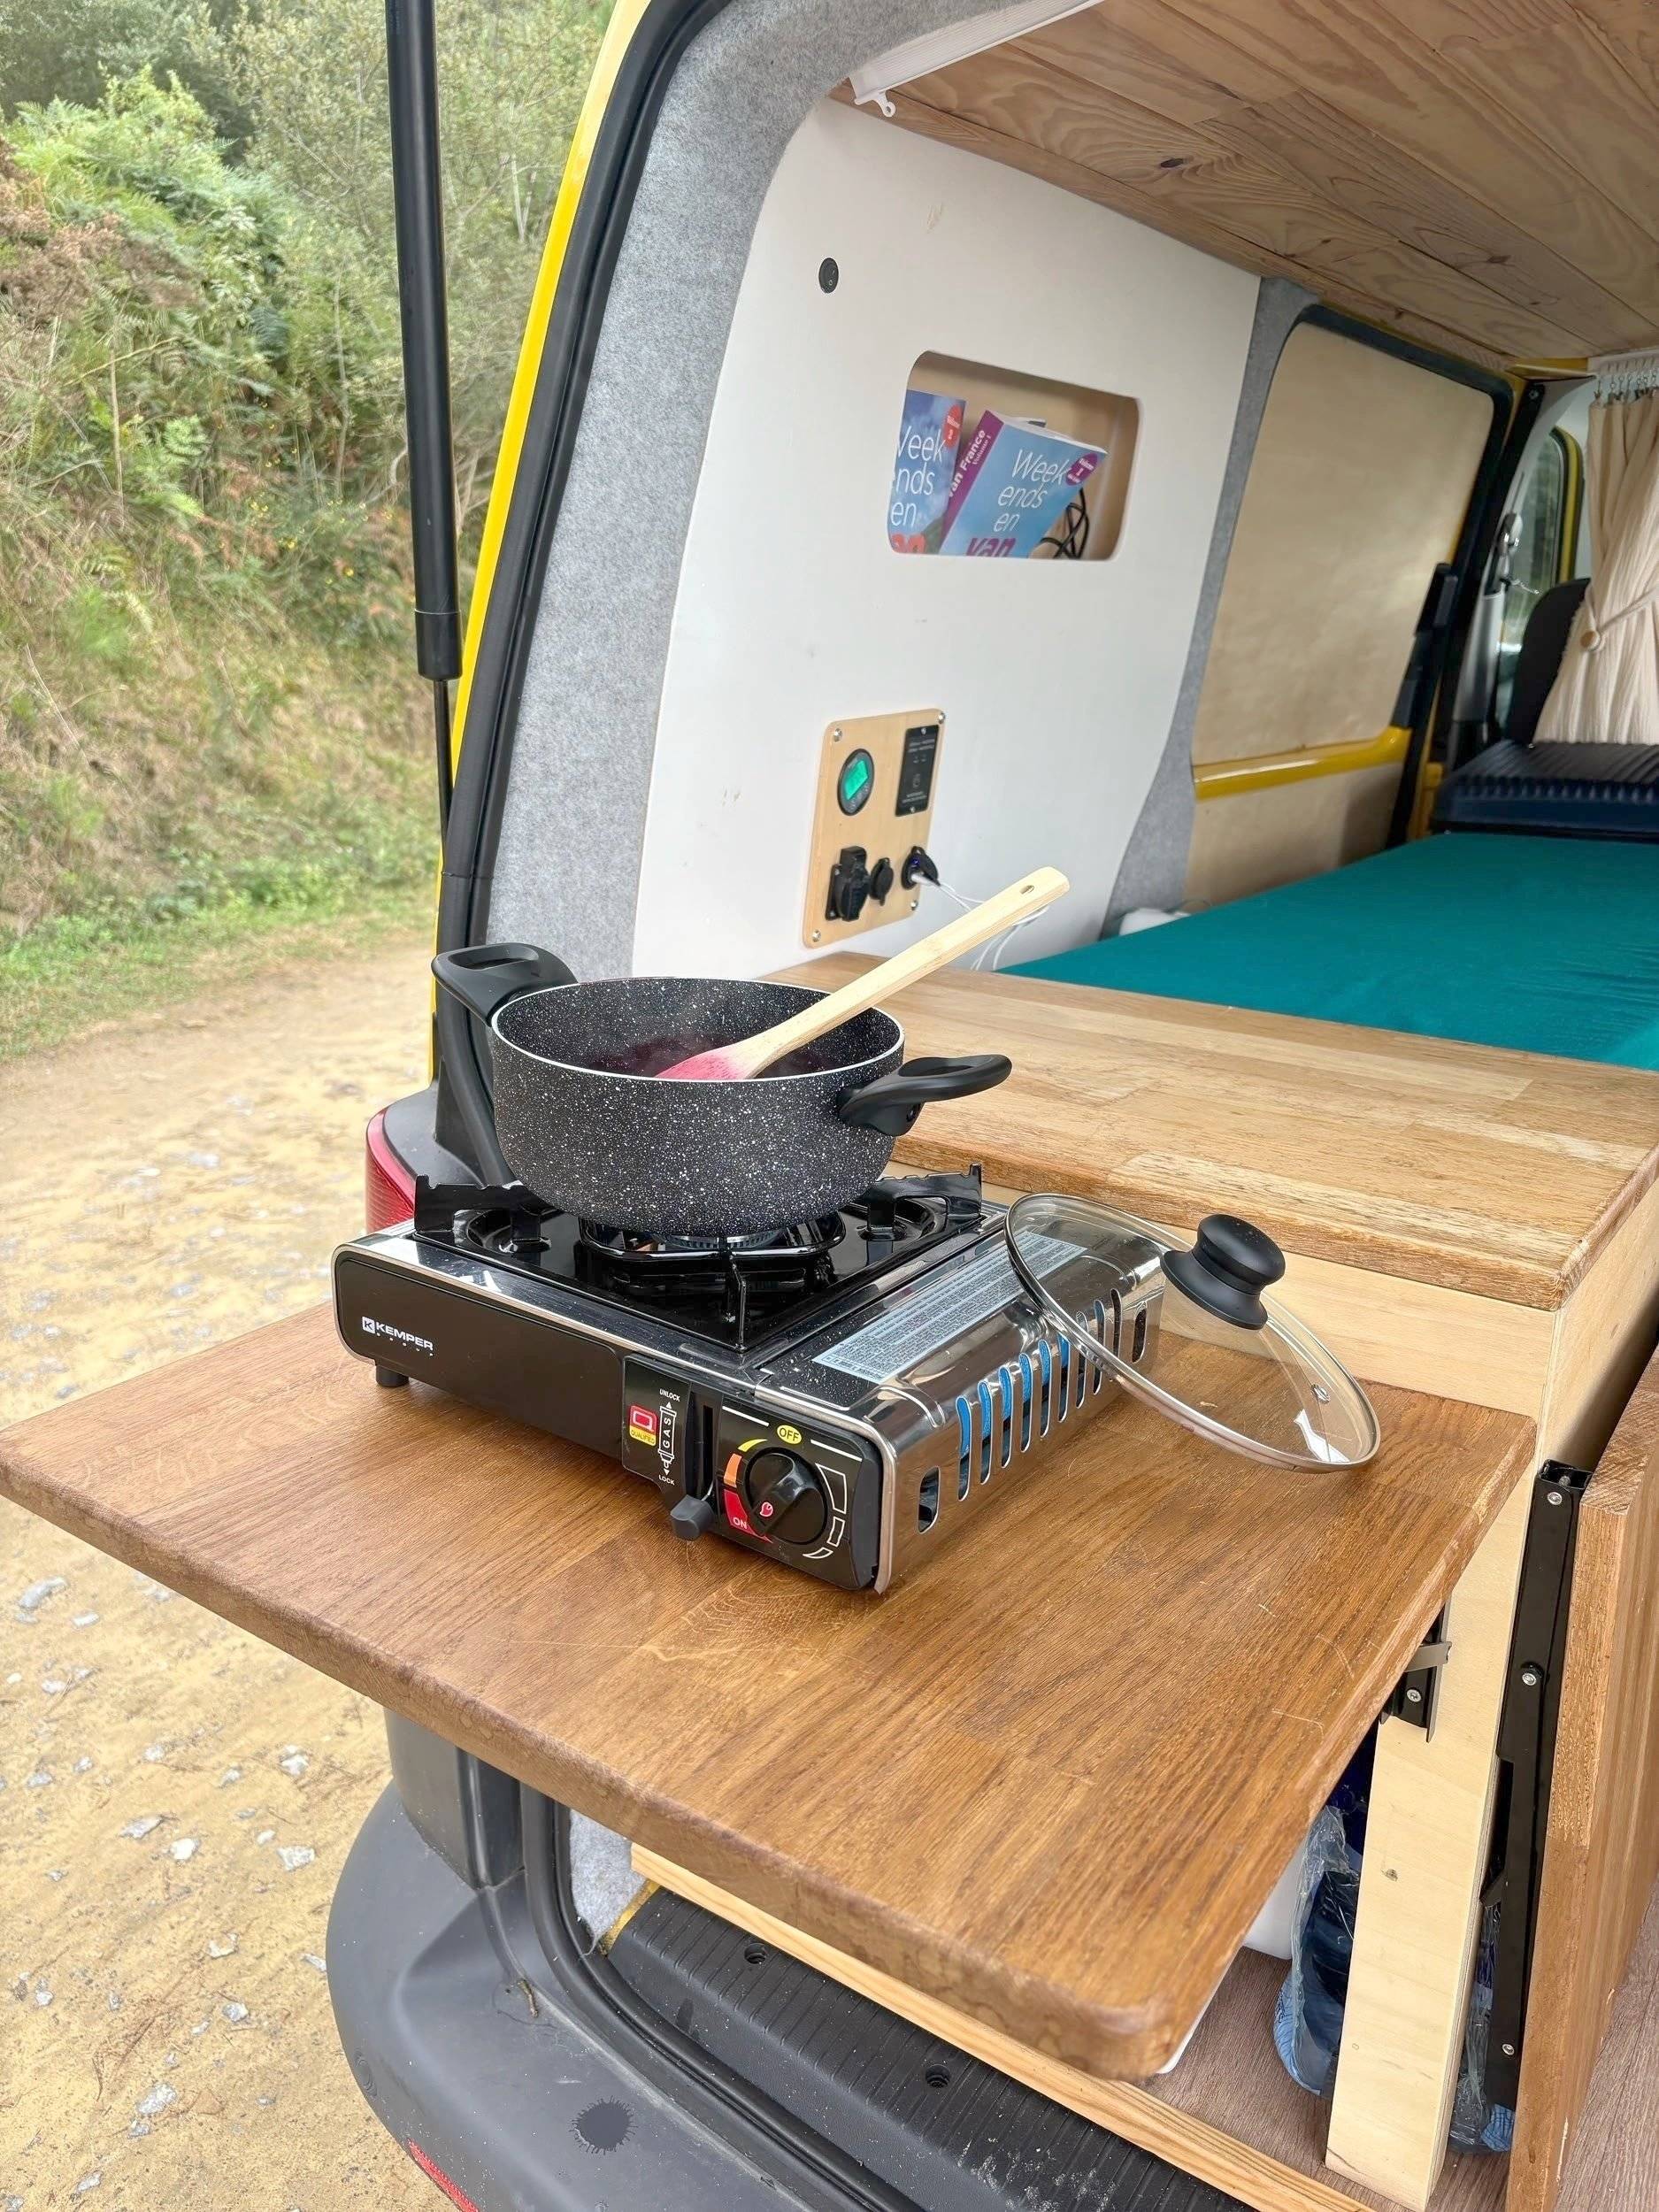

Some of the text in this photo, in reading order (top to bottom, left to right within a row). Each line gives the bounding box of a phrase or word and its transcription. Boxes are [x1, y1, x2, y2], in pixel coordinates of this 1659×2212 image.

[960, 430, 986, 471] France
[893, 462, 935, 495] nds
[1011, 449, 1071, 485] Week
[997, 482, 1048, 509] ends
[890, 501, 917, 528] en
[993, 512, 1020, 532] en
[966, 537, 1017, 557] van
[375, 1321, 434, 1350] KEMPER
[659, 1388, 680, 1402] UNLOCK
[631, 1429, 656, 1445] QUALIFIED
[663, 1417, 672, 1448] GAS
[779, 1426, 799, 1442] OFF
[658, 1474, 675, 1486] LOCK
[733, 1517, 748, 1530] ON
